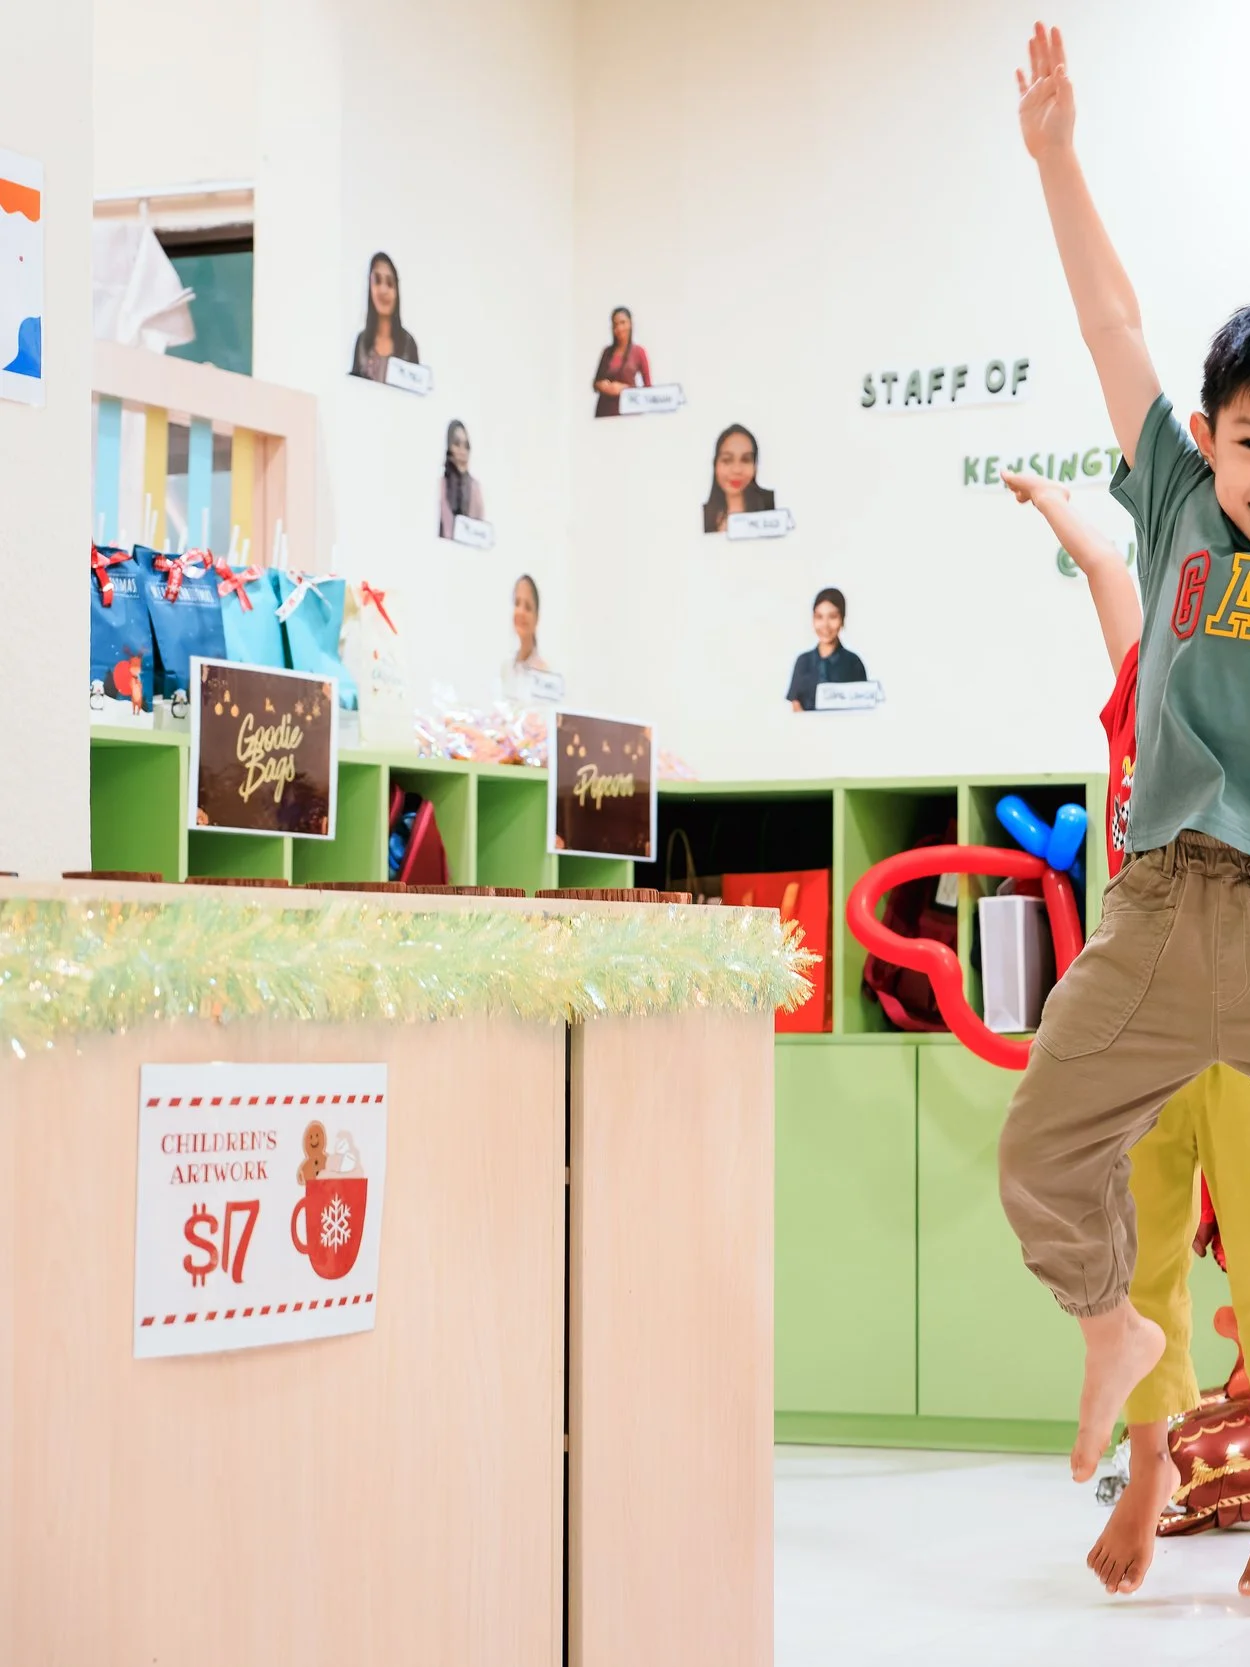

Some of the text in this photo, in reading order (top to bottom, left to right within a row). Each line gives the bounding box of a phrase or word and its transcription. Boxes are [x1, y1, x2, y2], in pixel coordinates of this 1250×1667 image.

[861, 357, 1030, 408] STAFF OF
[236, 712, 304, 761] Goodie
[238, 751, 296, 803] Bags
[161, 1130, 278, 1155] CHILDREN'S
[170, 1160, 269, 1185] ARTWORK
[183, 1199, 260, 1288] $7
